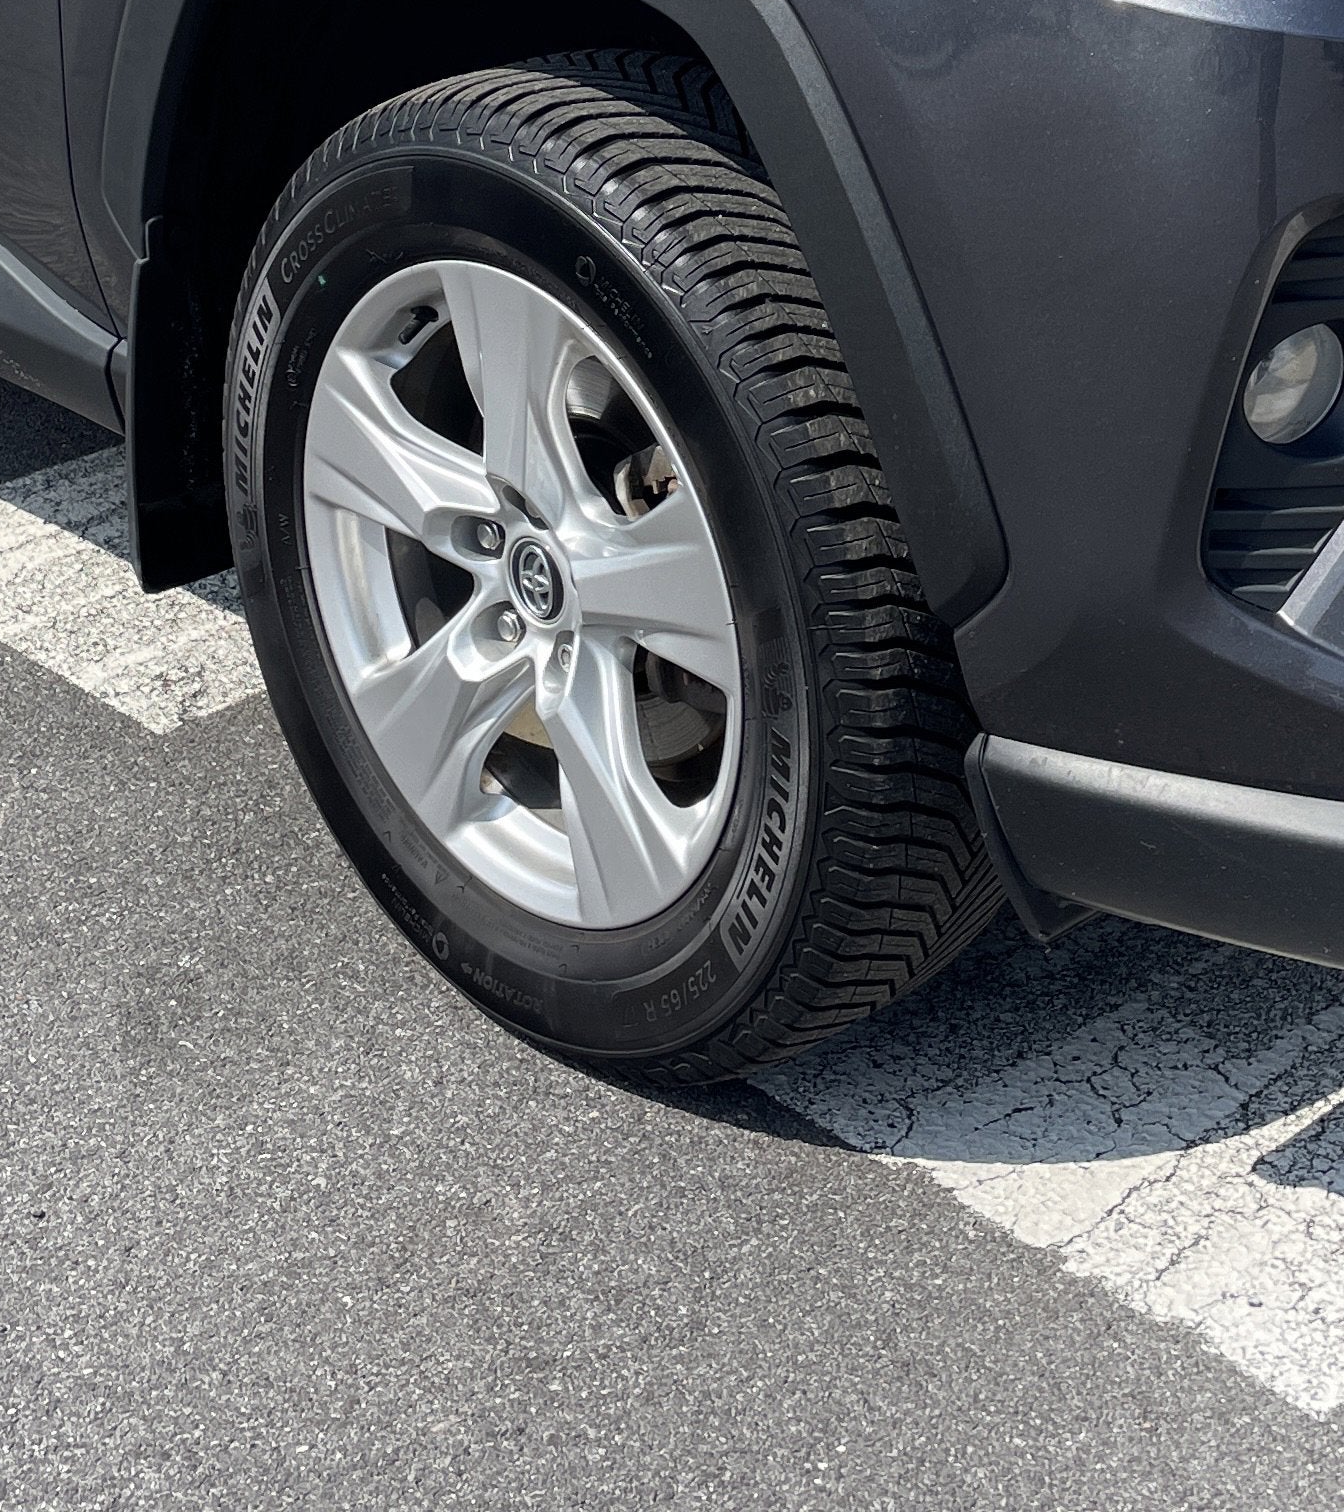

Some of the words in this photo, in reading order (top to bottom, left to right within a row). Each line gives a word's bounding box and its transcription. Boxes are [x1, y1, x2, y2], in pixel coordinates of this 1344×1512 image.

[233, 293, 275, 498] MICHELIN
[727, 726, 793, 957] MICHELIN
[660, 959, 717, 1018] 225/65
